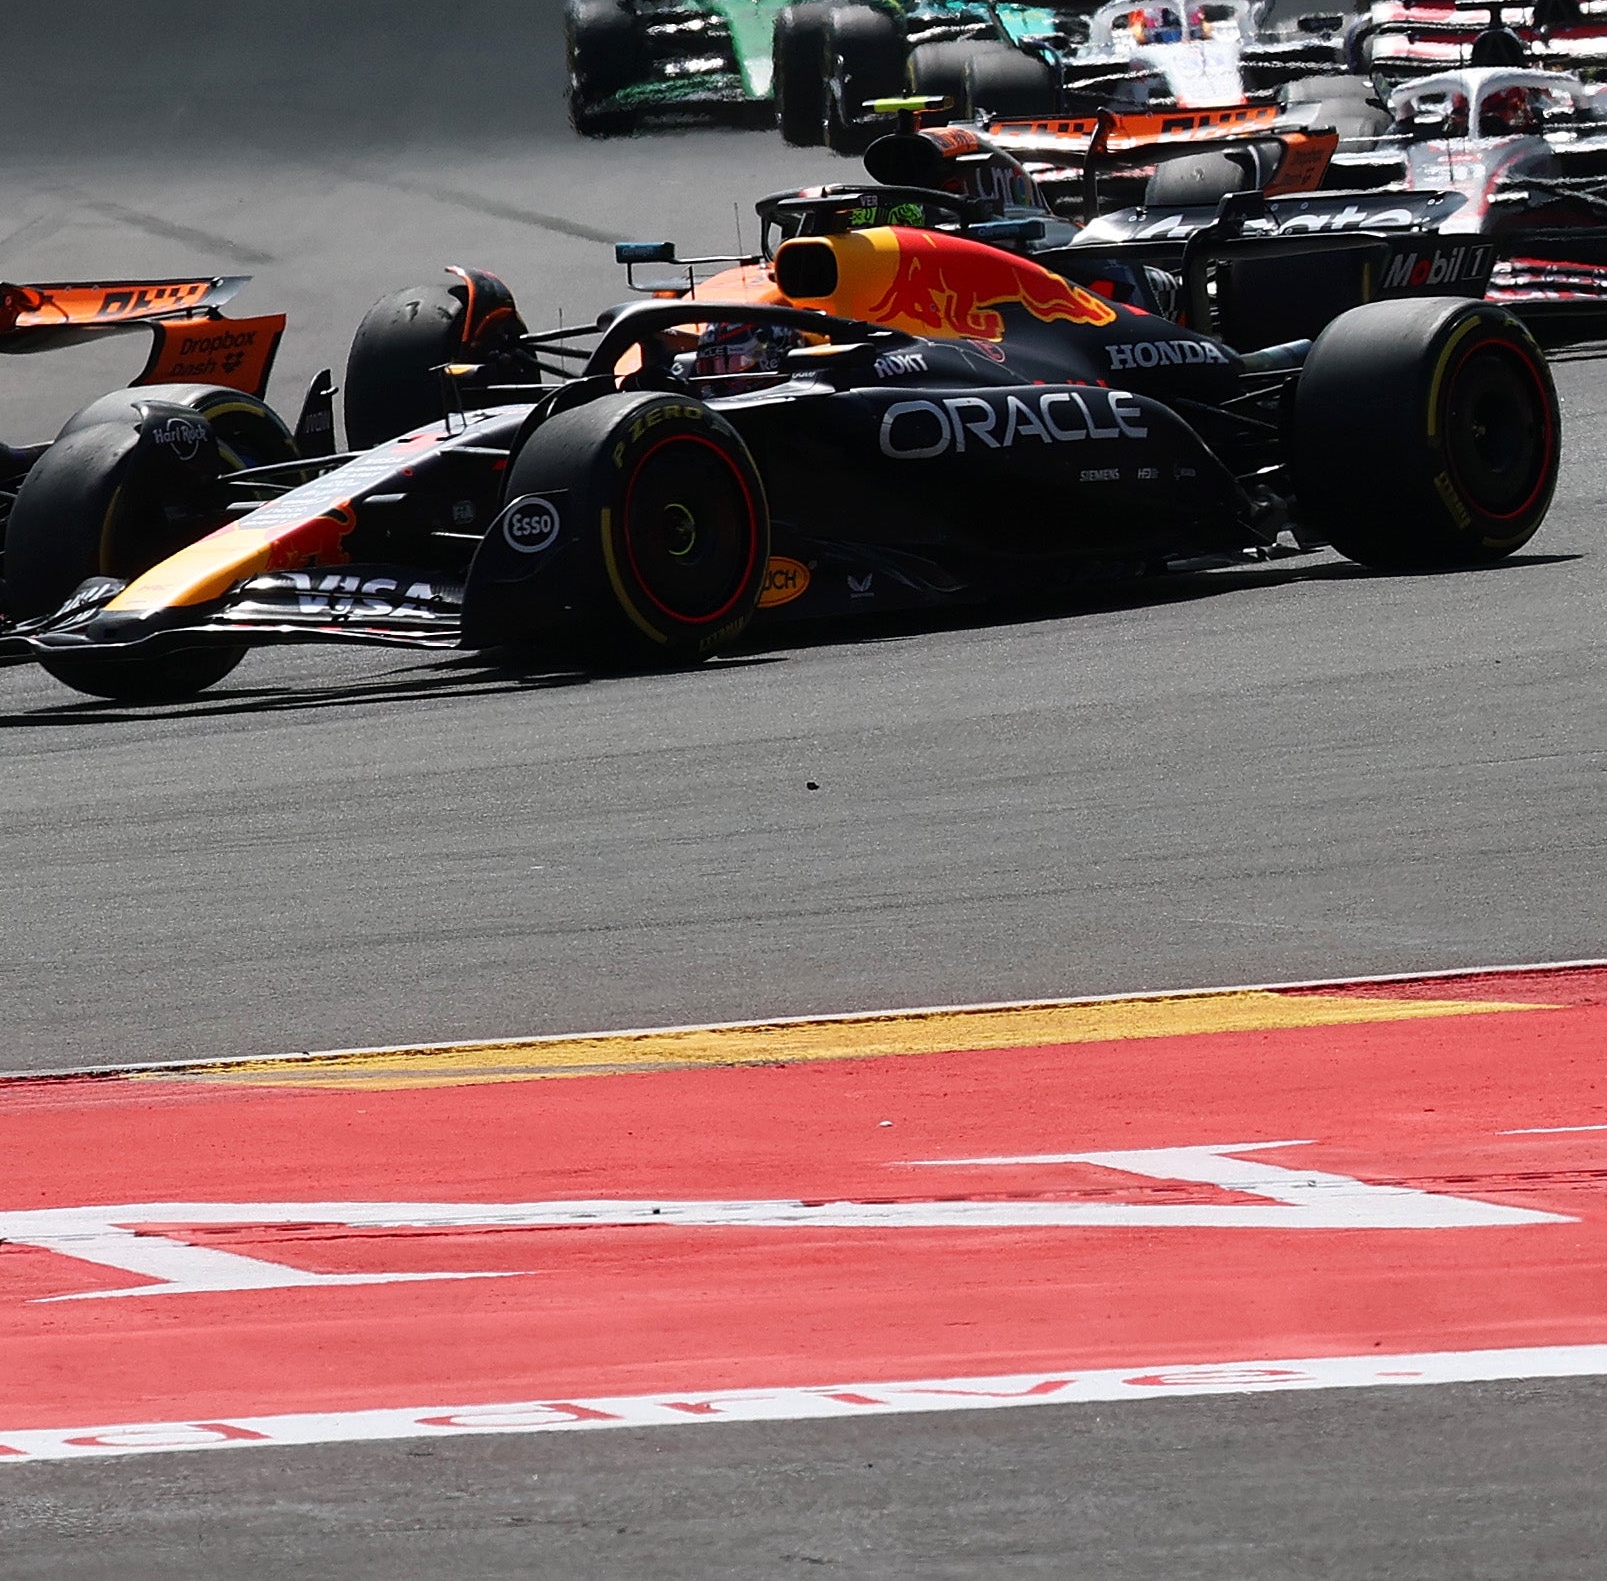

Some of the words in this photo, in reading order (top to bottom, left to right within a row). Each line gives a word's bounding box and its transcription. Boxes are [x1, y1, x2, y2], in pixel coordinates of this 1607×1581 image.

[860, 194, 879, 207] VER
[1383, 246, 1466, 289] Mobil
[180, 329, 257, 357] Dropbox
[1104, 339, 1230, 371] HONDA
[169, 359, 216, 378] Dash
[878, 390, 1149, 460] ORACLE
[286, 572, 447, 619] VISA
